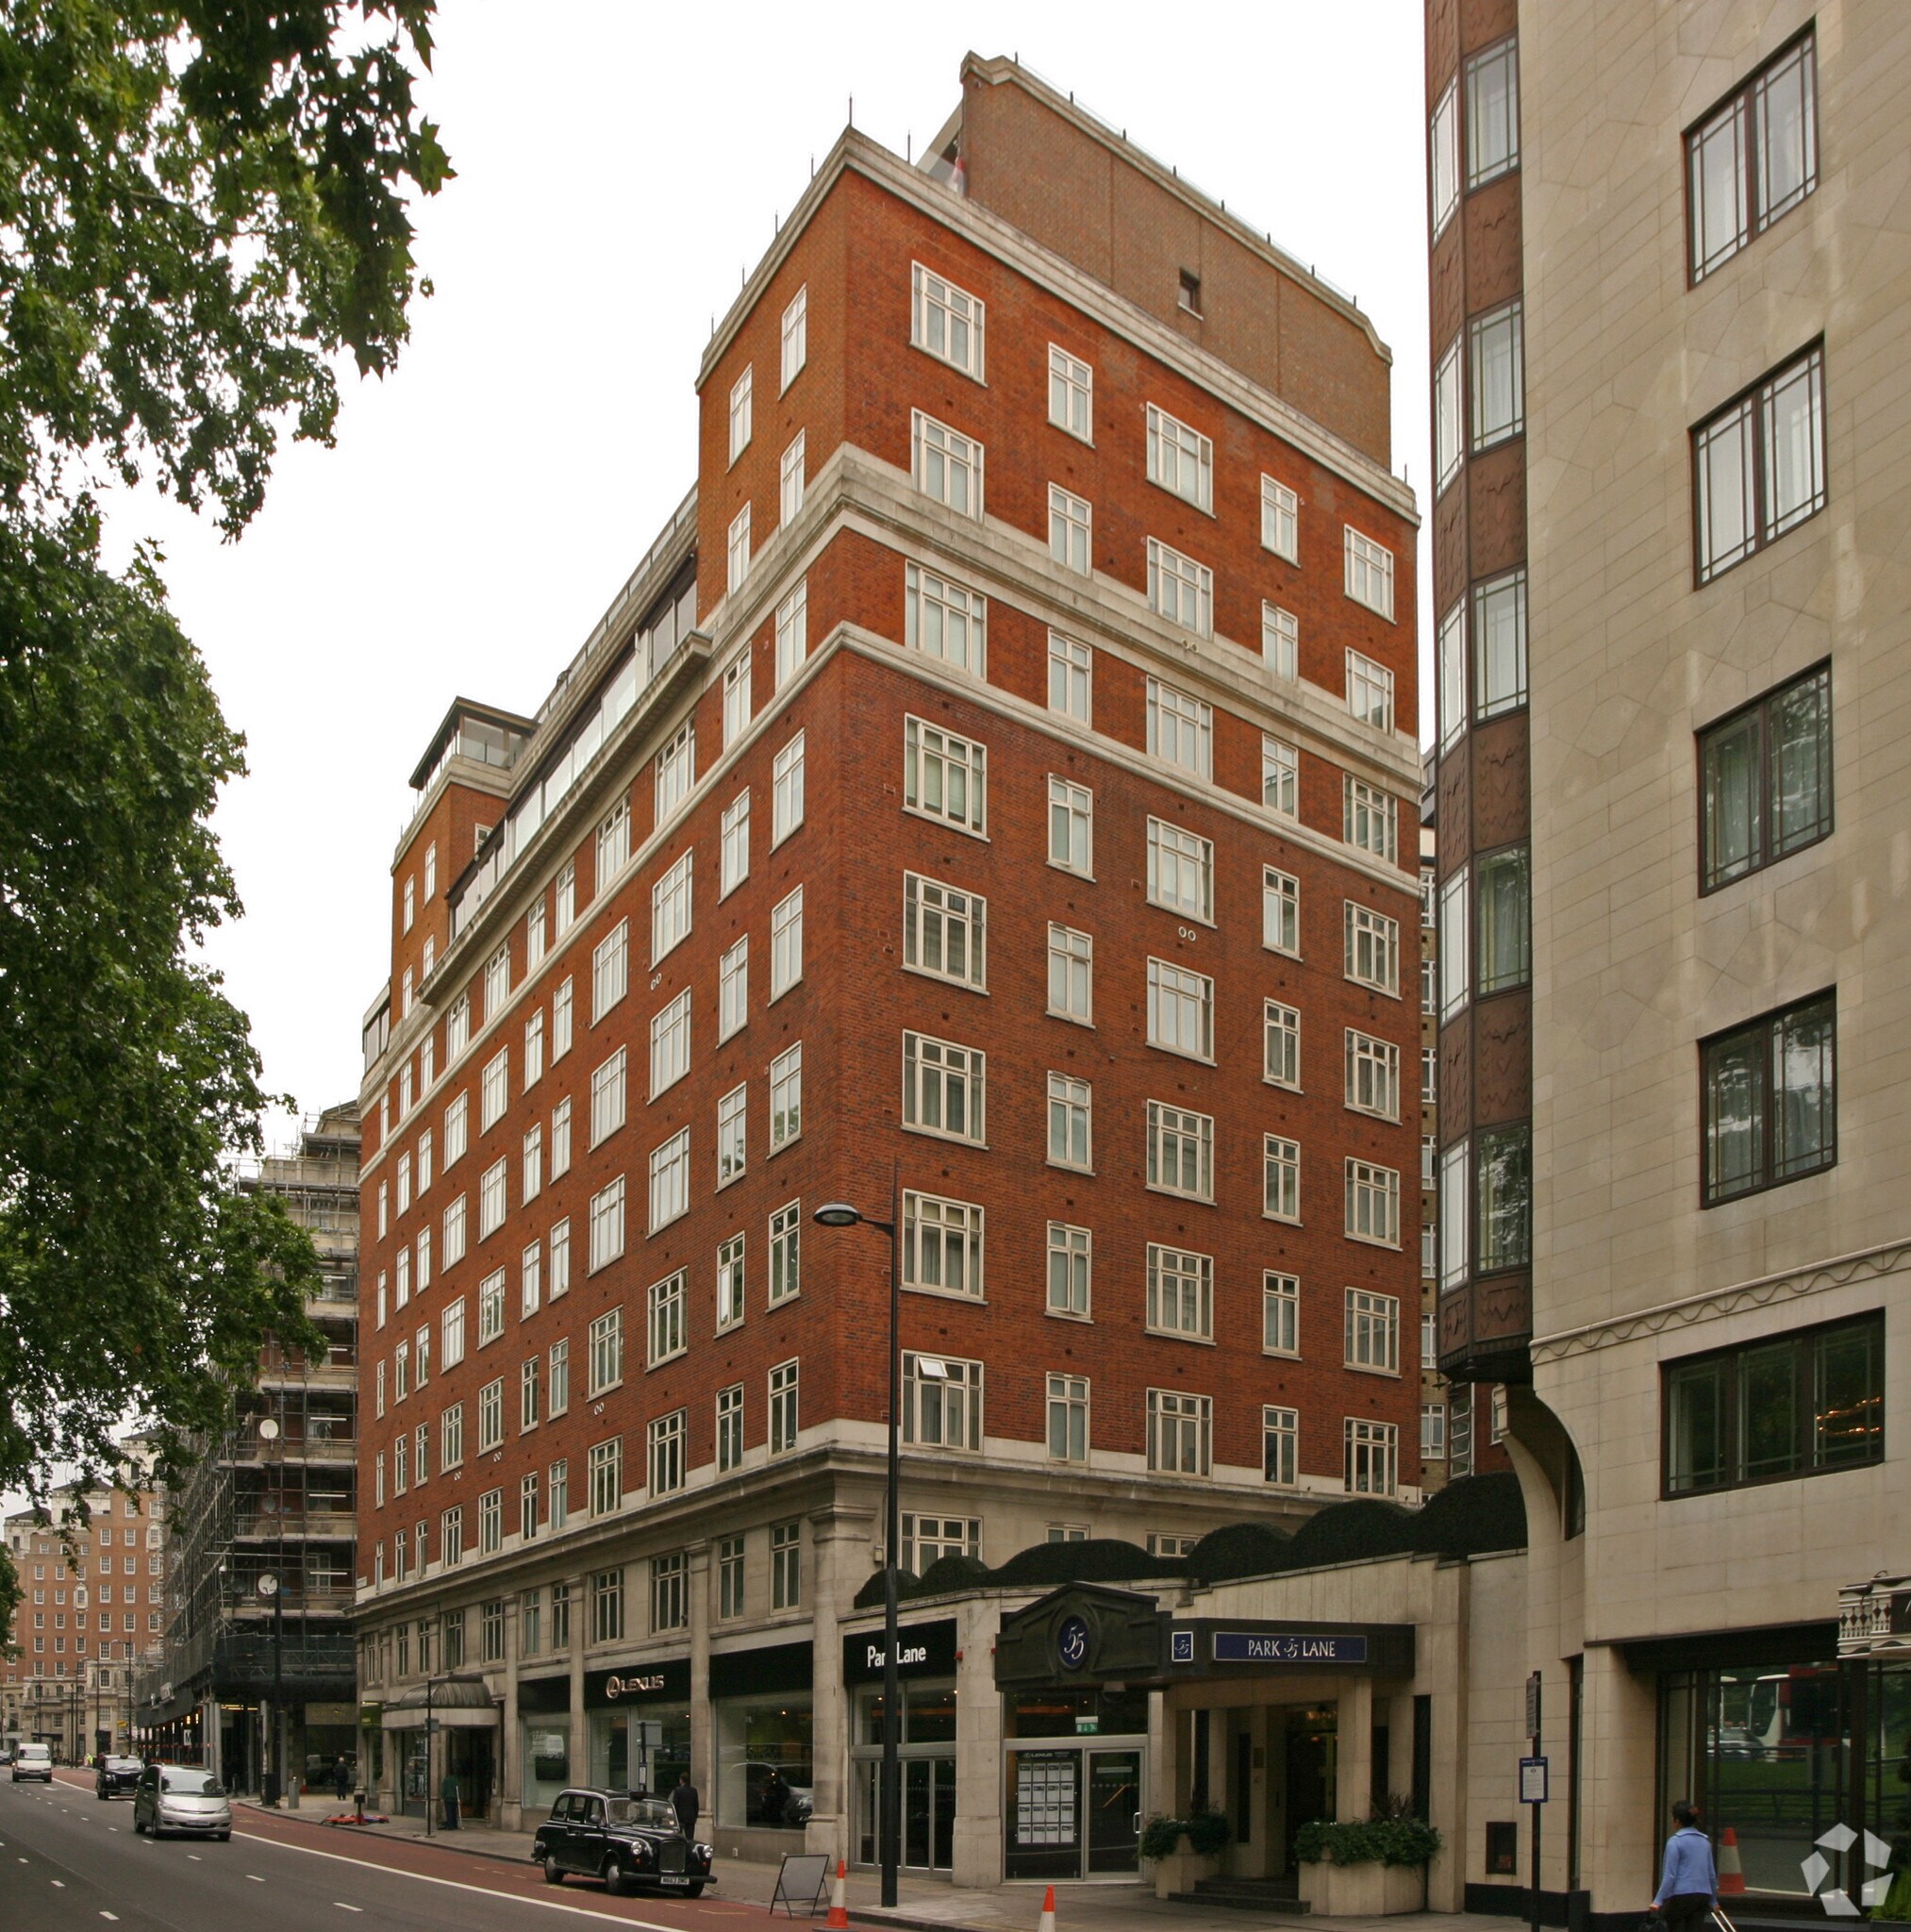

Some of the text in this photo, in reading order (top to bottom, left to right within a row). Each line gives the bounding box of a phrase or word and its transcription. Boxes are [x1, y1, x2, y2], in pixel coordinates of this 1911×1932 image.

[1064, 1624, 1085, 1659] 55
[1248, 1640, 1281, 1657] PARK
[1303, 1641, 1336, 1657] LANE
[867, 1641, 926, 1668] Par Lane
[621, 1674, 664, 1691] LEXUS
